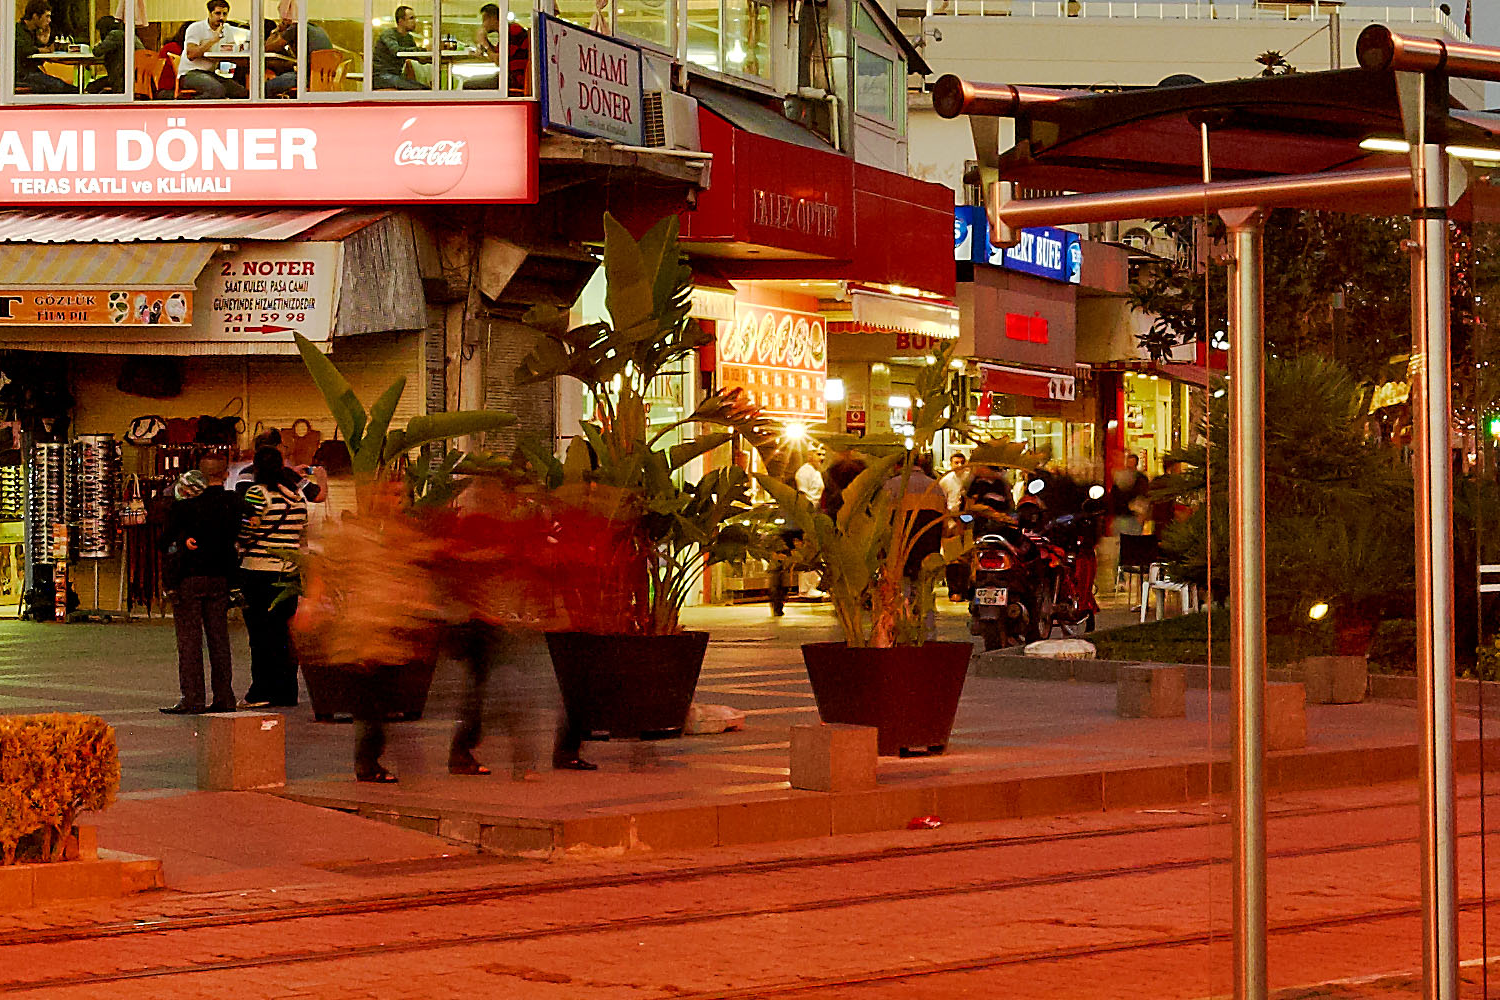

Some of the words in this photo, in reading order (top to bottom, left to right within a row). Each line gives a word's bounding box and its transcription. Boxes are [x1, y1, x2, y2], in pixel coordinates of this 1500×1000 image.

[578, 44, 628, 87] MİAMİ
[578, 80, 632, 124] DÖNER
[116, 117, 318, 172] DÖNER
[394, 140, 467, 166] Coca-Cola
[11, 178, 70, 194] TERAS
[75, 177, 126, 194] KATLI
[131, 181, 152, 194] ve
[157, 173, 232, 194] KLİMALI
[220, 261, 237, 276] 2.
[242, 261, 315, 276] NOTER
[34, 293, 97, 306] GÖZLÜK
[224, 313, 252, 322] 241
[259, 313, 280, 322] 59
[285, 312, 305, 322] 98
